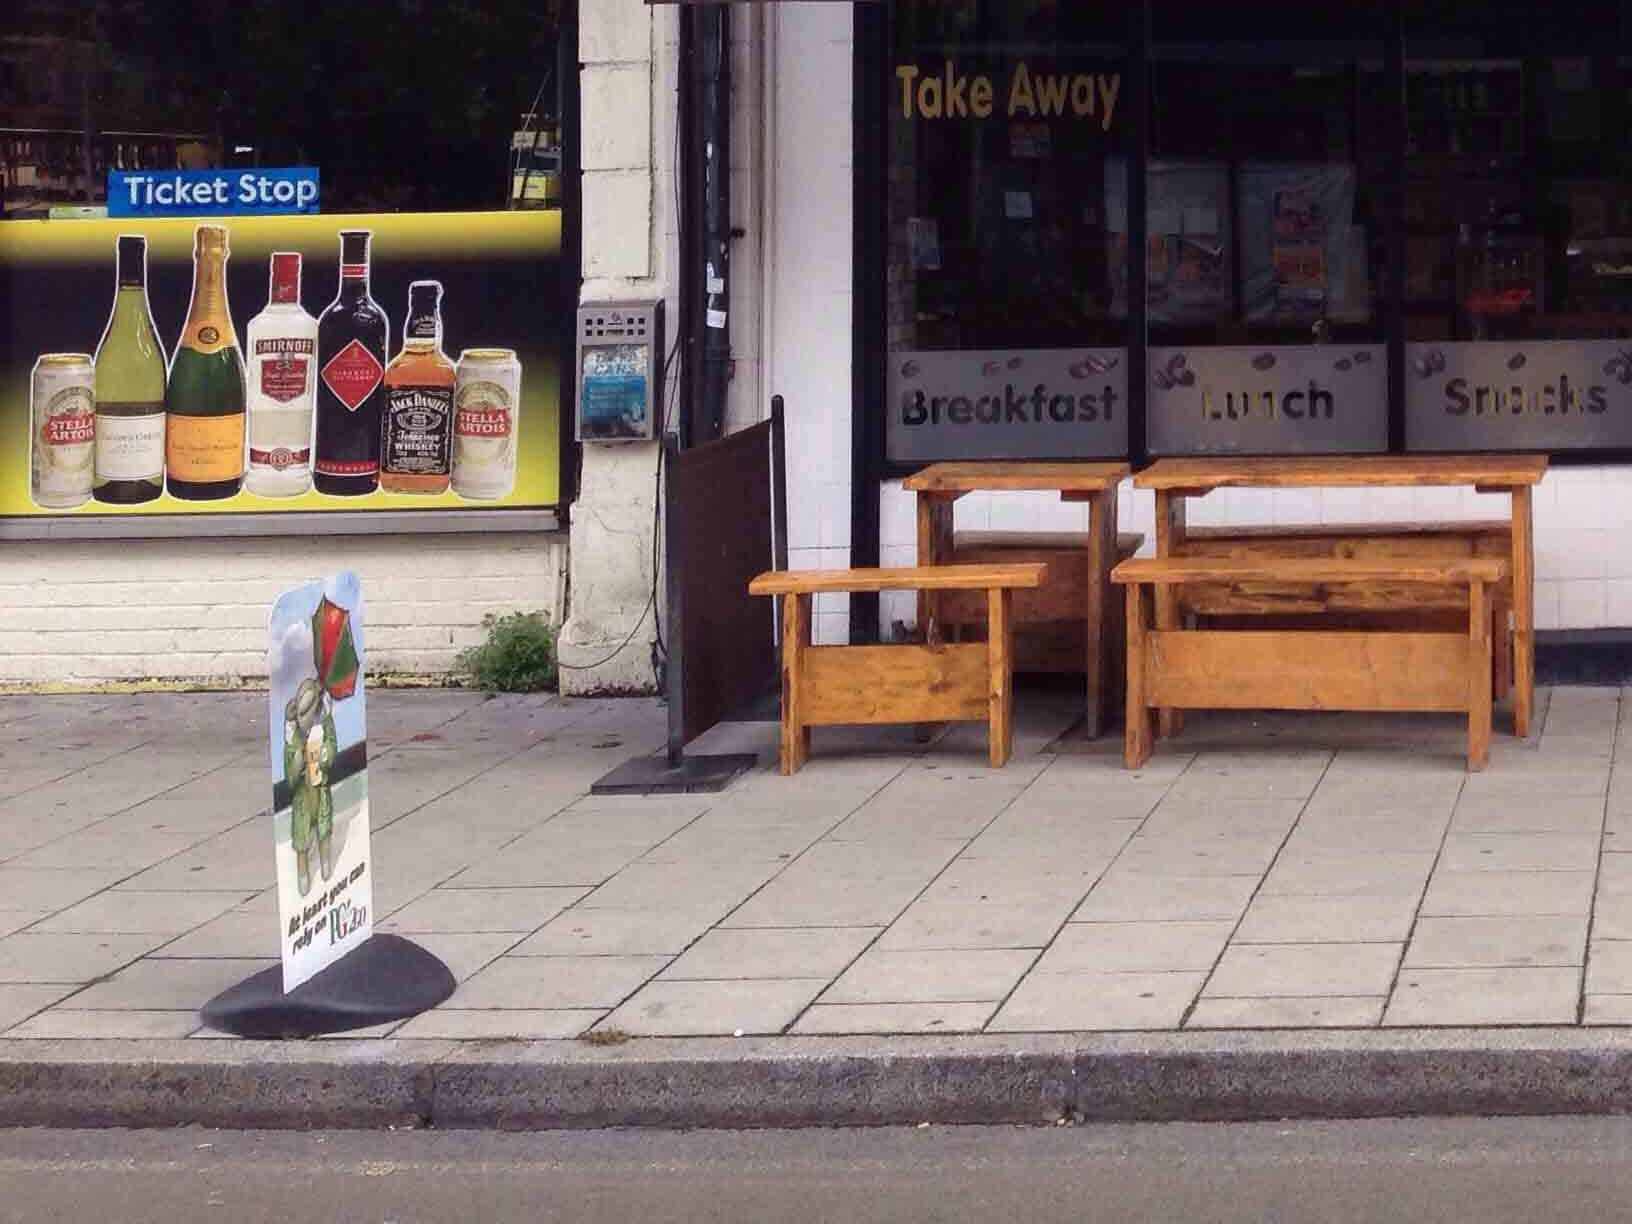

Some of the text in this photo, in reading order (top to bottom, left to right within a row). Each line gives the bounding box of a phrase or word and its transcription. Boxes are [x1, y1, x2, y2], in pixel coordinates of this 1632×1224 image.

[896, 60, 1120, 131] Take Away
[123, 174, 317, 208] Ticket Stop
[257, 340, 312, 353] SMIRNOFF
[900, 383, 1118, 426] Breakfast
[1202, 379, 1334, 420] Lunch
[1445, 373, 1609, 416] Snacks
[459, 411, 505, 423] STELLA
[460, 422, 506, 434] ARTOIS
[49, 428, 95, 441] ARTOIS
